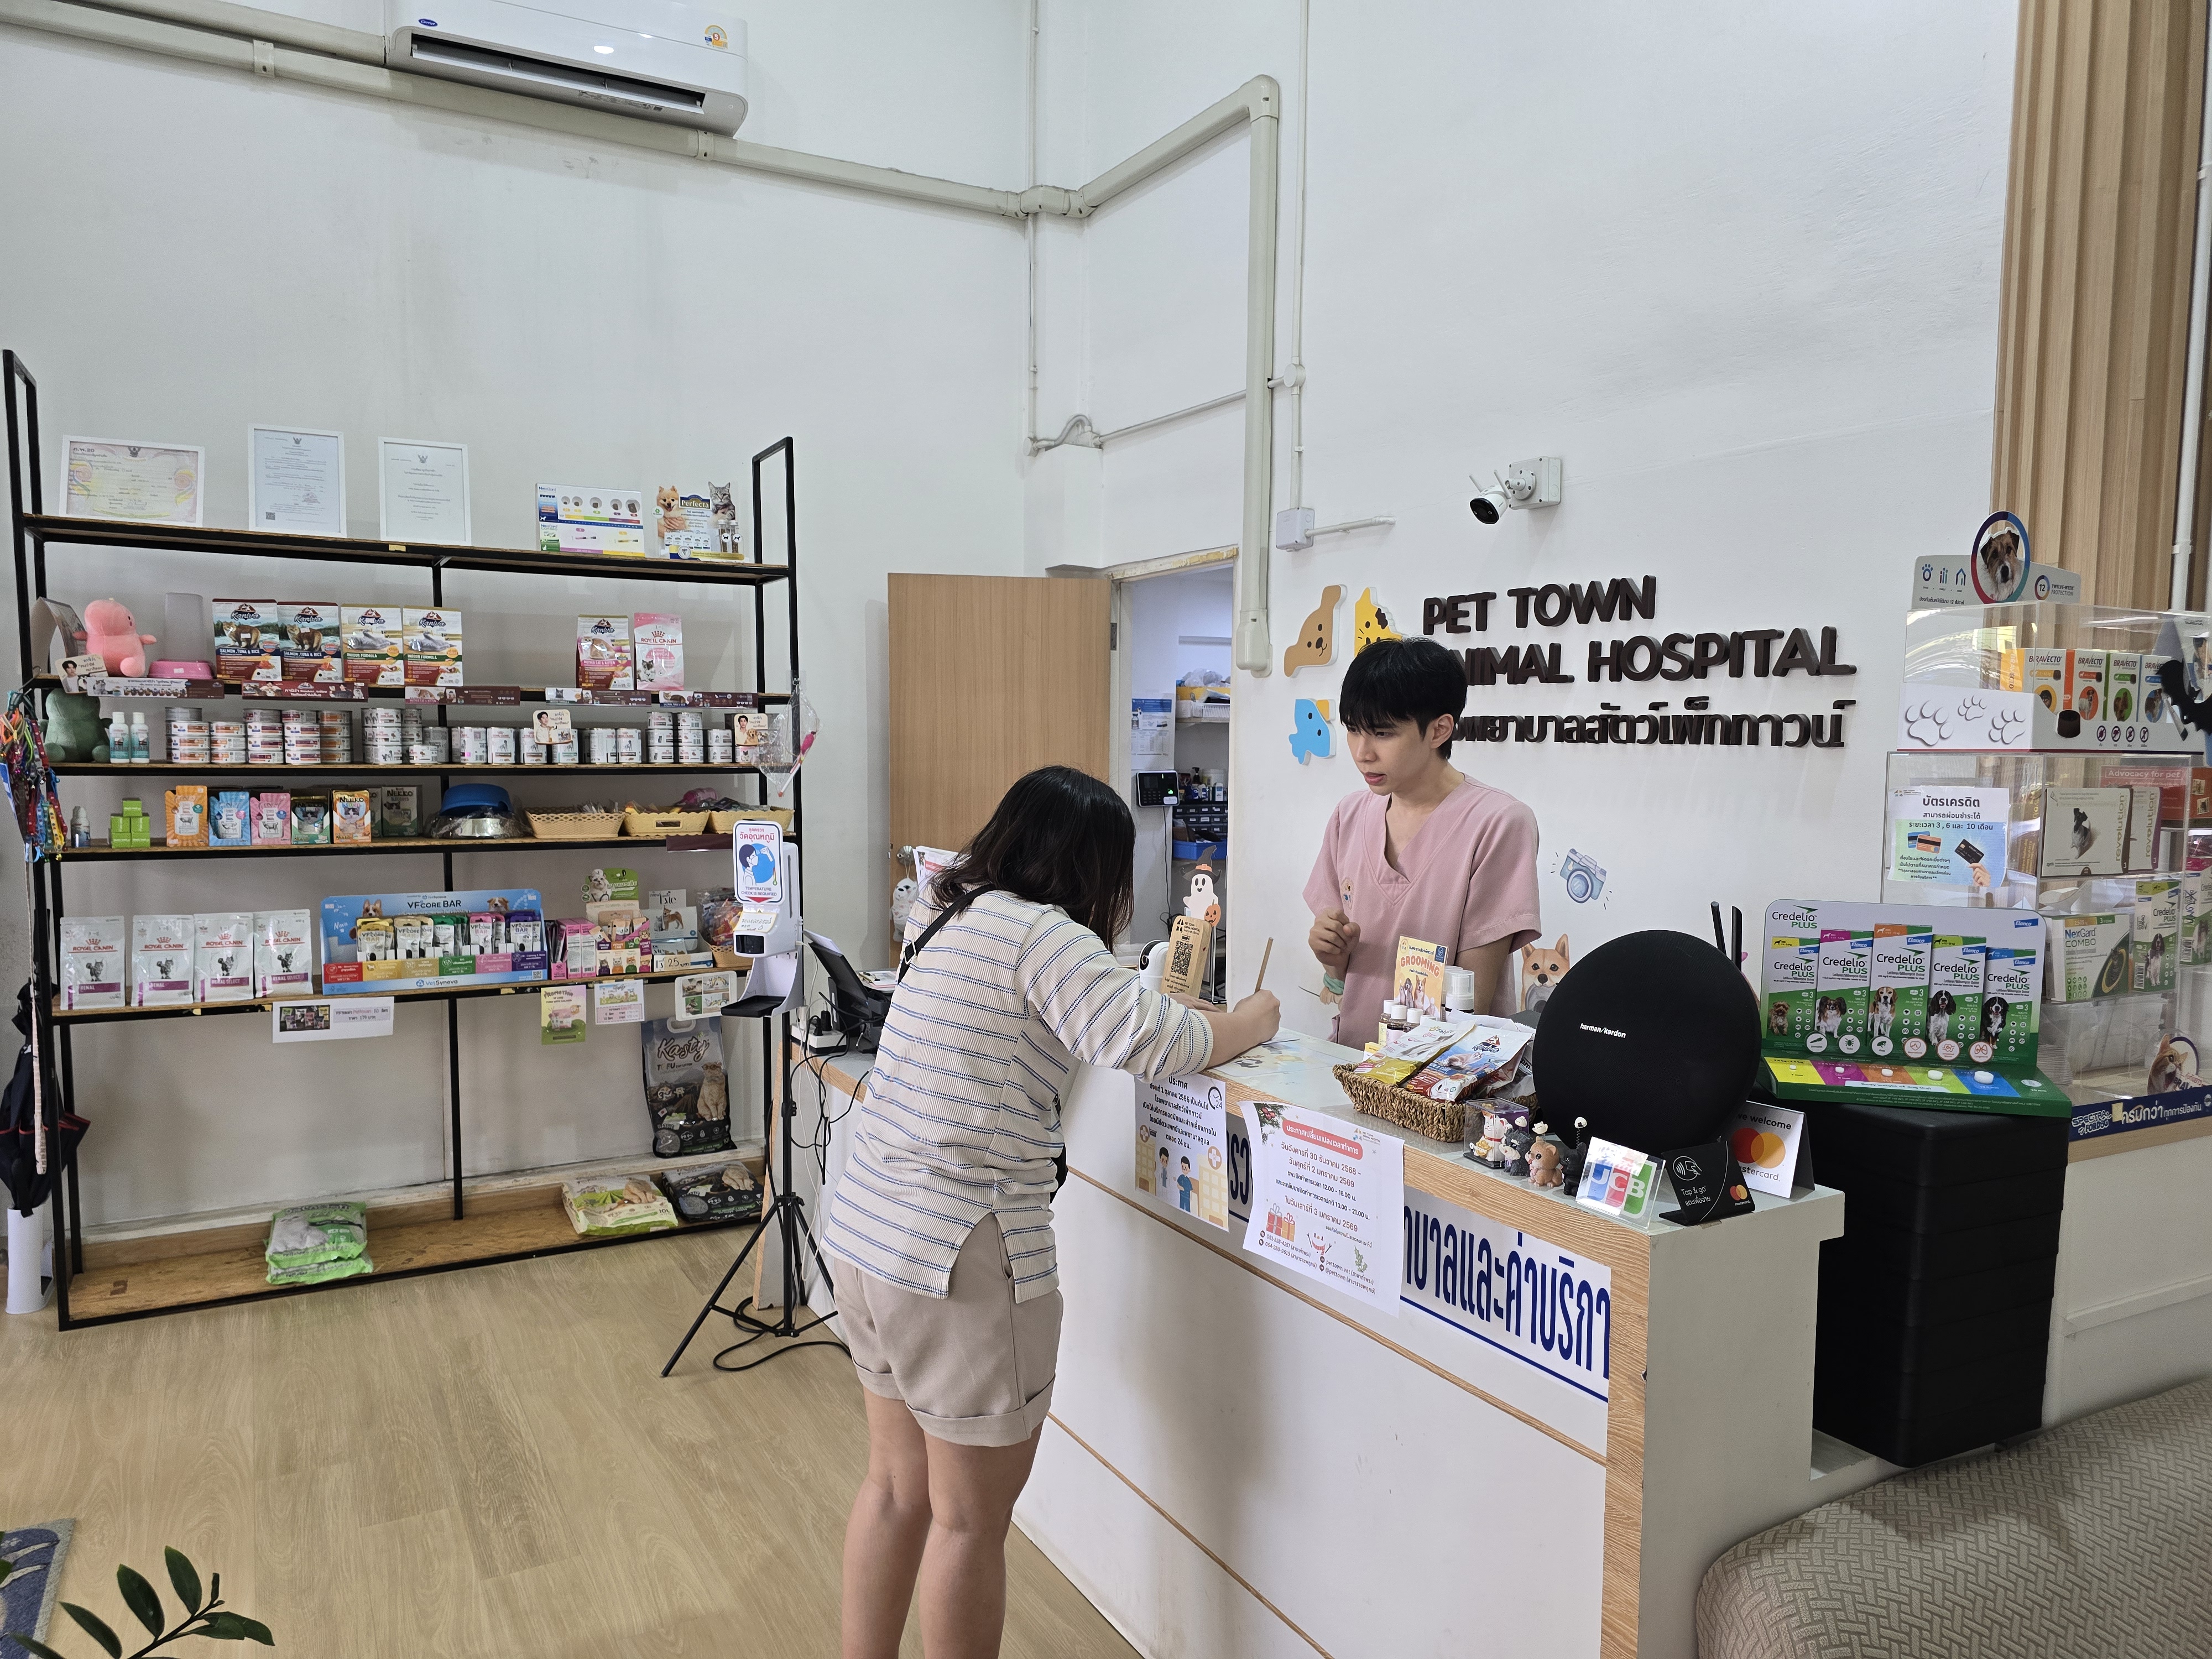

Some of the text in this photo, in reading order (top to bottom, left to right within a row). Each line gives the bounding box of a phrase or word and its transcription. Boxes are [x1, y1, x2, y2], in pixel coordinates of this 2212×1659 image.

[681, 499, 709, 508] Perfecta
[2039, 583, 2046, 592] 12
[1423, 575, 1657, 636] PET TOWN
[231, 611, 260, 620] Kaniva
[294, 614, 323, 623] Kaniva
[419, 618, 446, 627] Kaniva
[591, 625, 615, 634] Kaniva
[1448, 627, 1857, 686] NIMAL HOSPITAL
[2028, 653, 2062, 664] BRAVECTO
[2078, 656, 2103, 665] BRAVECTO
[2114, 659, 2137, 668] BRAVECTO
[1923, 795, 1980, 807] บัตรเครดิต
[2116, 792, 2125, 861] revolution
[2146, 791, 2154, 857] revolution
[739, 831, 775, 843] วัดอุณหภูมิ
[1772, 911, 1815, 922] Credelio
[2065, 929, 2096, 938] NexGard
[2065, 939, 2096, 947] COMBO
[667, 958, 679, 967] 25
[1823, 957, 1865, 967] Credelio
[1876, 954, 1922, 964] Credelio
[1400, 955, 1440, 977] GROOMING
[1774, 962, 1812, 971] Credelio
[1897, 964, 1925, 972] PLUS
[1934, 963, 1977, 973] Credelio
[1987, 974, 2027, 983] Credelio
[1580, 1023, 1626, 1039] harman/kardon
[658, 1036, 710, 1062] Kasty
[1168, 1076, 1188, 1089] ประกาศ
[1164, 1088, 1178, 1098] ตุลาคม
[1178, 1093, 1190, 1103] 2566
[1190, 1096, 1209, 1110] เป็นต้นไป
[1215, 1100, 1223, 1109] 24
[1750, 1115, 1792, 1130] welcome
[2072, 1110, 2106, 1126] SPECTRA
[1166, 1134, 1177, 1144] ตลอด
[1177, 1138, 1183, 1146] 24
[1286, 1125, 1359, 1155] ประกาศเปลี่ยนแปลงเวลาทำการ
[1281, 1141, 1356, 1175] วันอังคารที่ 30 ธันวาคม 2568
[1289, 1156, 1311, 1172] วันศุกร์ที่
[1317, 1168, 1338, 1181] มกราคม
[1339, 1176, 1355, 1188] 2569
[1740, 1166, 1781, 1182] stercard.
[1322, 1183, 1334, 1193] 12.00
[1591, 1167, 1645, 1199] JCB
[1681, 1188, 1692, 1197] Tap
[1685, 1196, 1711, 1206] แตะเพื่อจ่าย
[1285, 1195, 1312, 1214] ในวันเสาร์ที่
[1319, 1211, 1341, 1225] มกราคม
[1342, 1219, 1358, 1232] 2569
[1335, 1201, 1348, 1211] 10.00
[1352, 1208, 1364, 1218] 21.00
[1326, 1259, 1350, 1275] pettown.vet
[1325, 1267, 1346, 1281] @pettown
